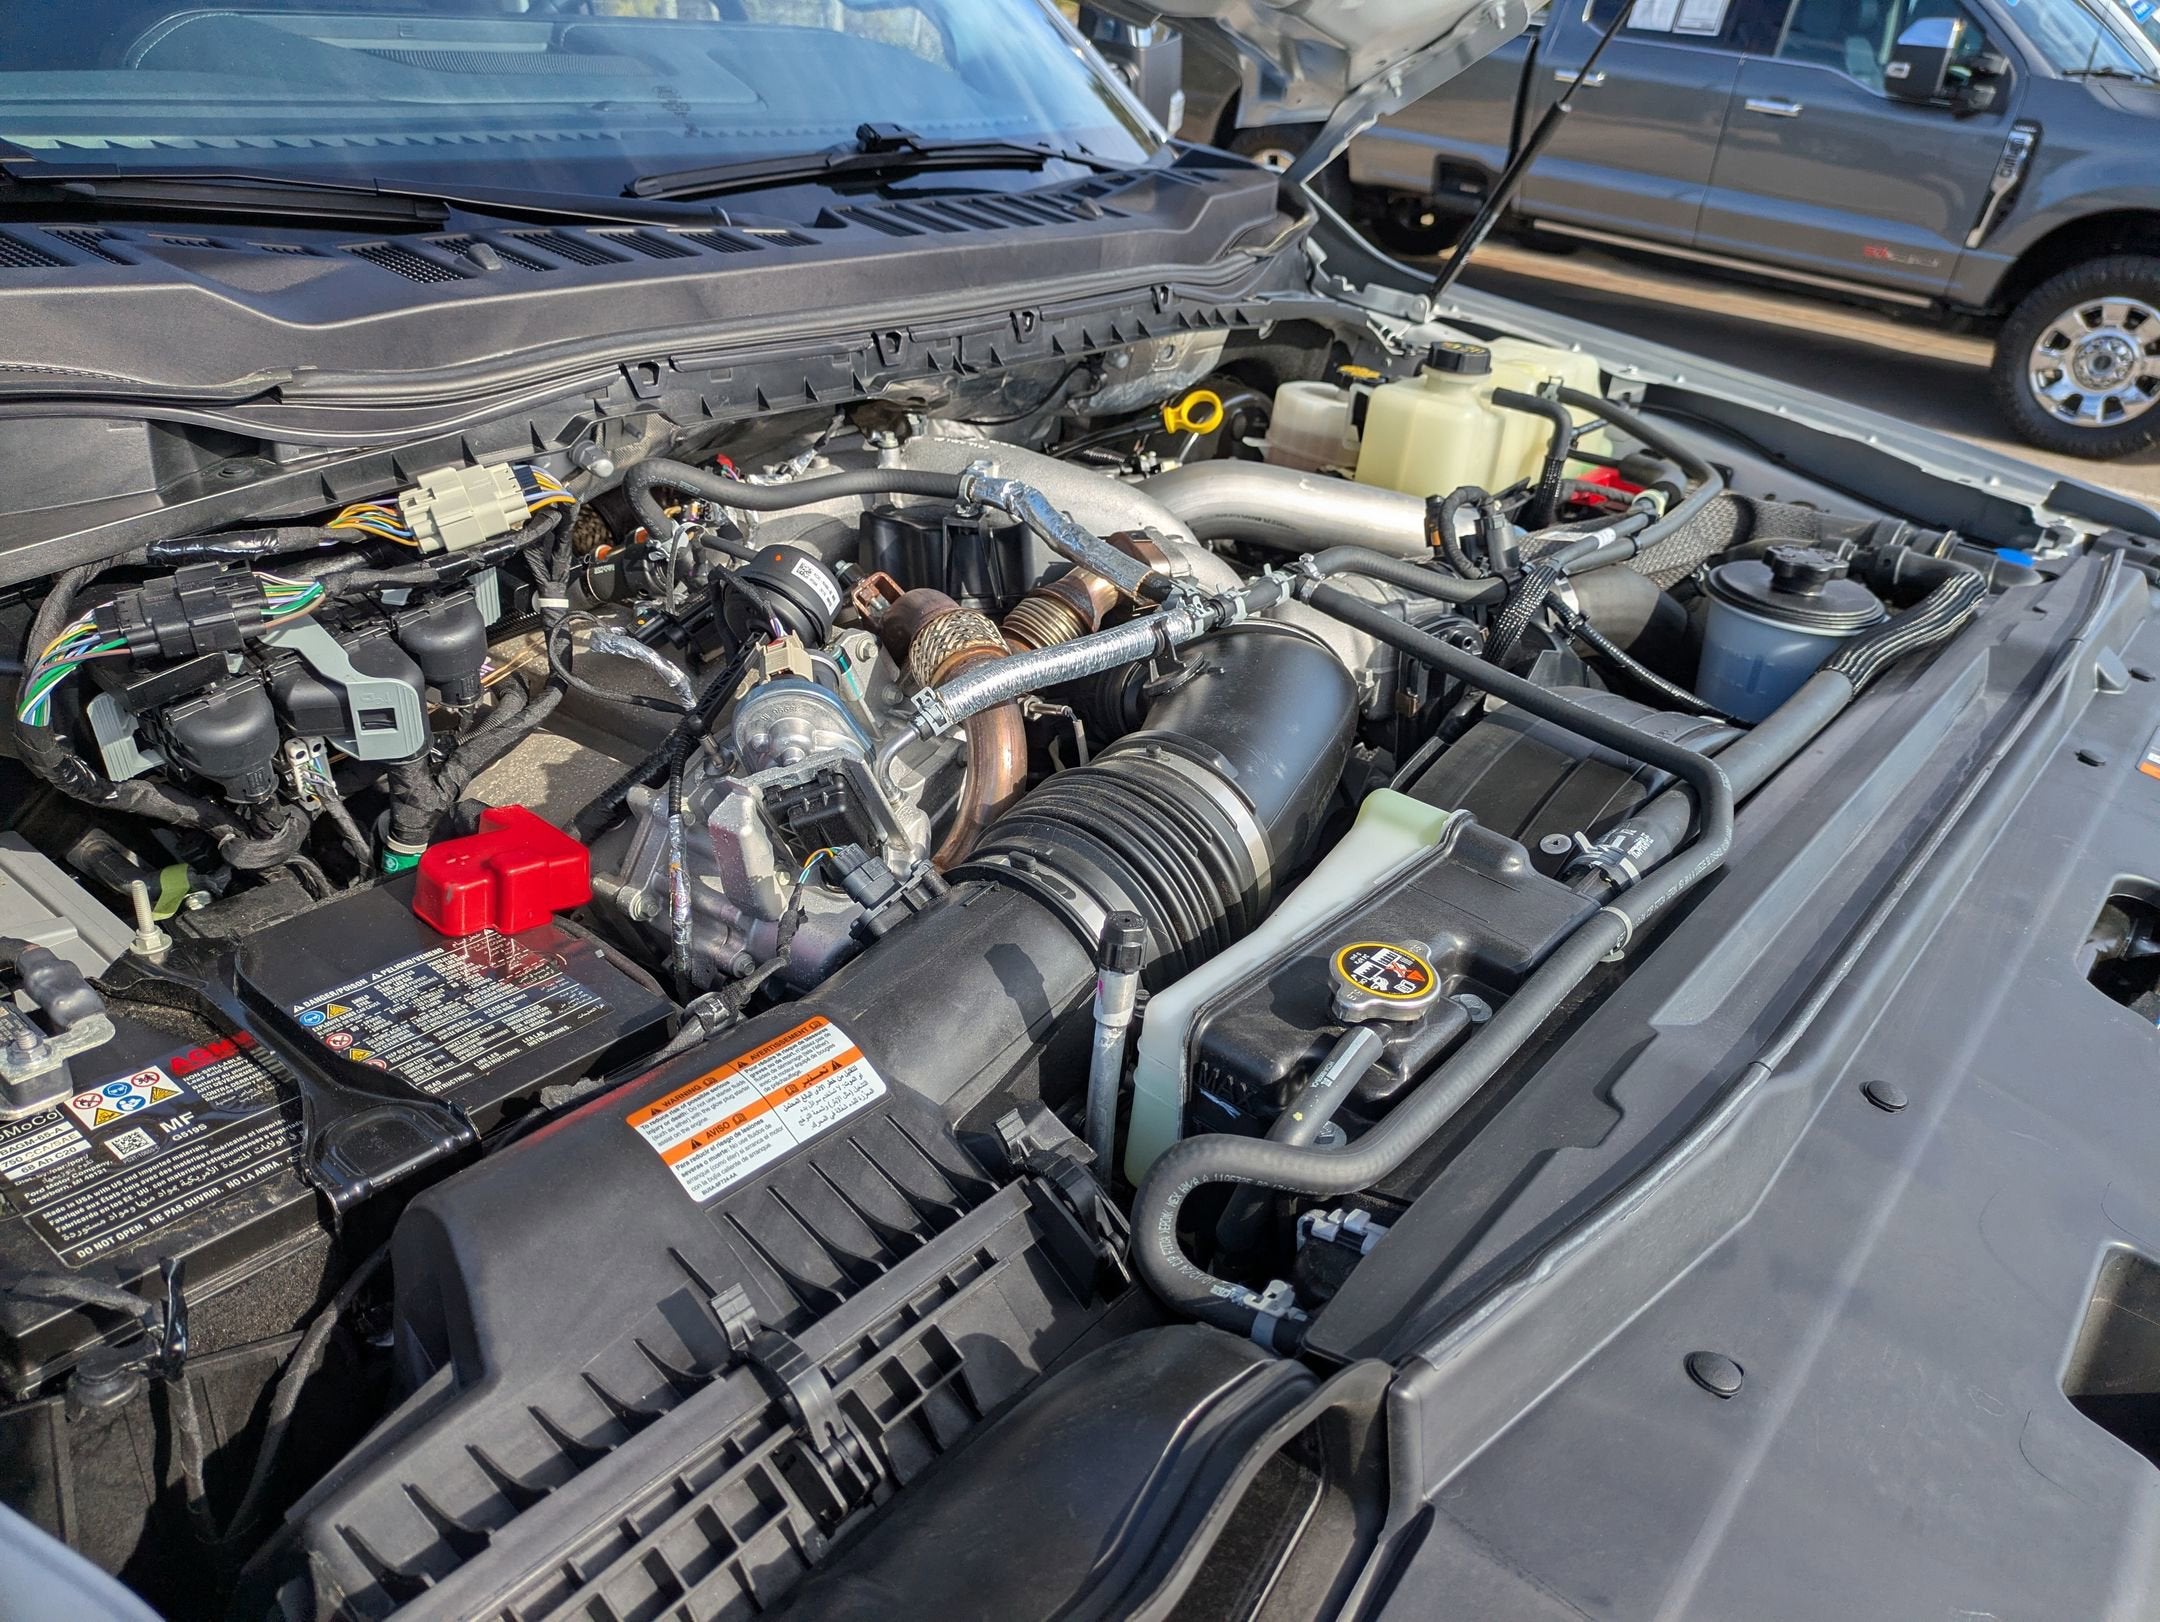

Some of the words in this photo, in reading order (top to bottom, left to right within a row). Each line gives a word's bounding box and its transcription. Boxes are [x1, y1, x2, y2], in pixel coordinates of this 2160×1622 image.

[301, 977, 369, 1008] DANGER/POISON
[379, 945, 444, 977] PELIGRO/VENENO
[521, 1035, 534, 1043] LEA
[532, 1030, 545, 1038] LAS
[749, 1026, 809, 1061] AVERTISSEMENT
[186, 1075, 206, 1086] Lead
[205, 1068, 223, 1078] Acid
[223, 1057, 249, 1071] Battery
[744, 1064, 758, 1073] Pour
[648, 1112, 669, 1126] reduce
[686, 1090, 711, 1106] possible
[708, 1079, 730, 1093] serious
[661, 1083, 702, 1108] WARNING
[709, 1099, 723, 1109] glow
[722, 1093, 735, 1103] plug
[715, 1086, 732, 1097] starter
[158, 1110, 197, 1134] MF
[703, 1120, 732, 1139] AVISO
[1, 1155, 23, 1168] 750
[23, 1132, 78, 1159] CCA/SAE
[54, 1145, 77, 1159] C20
[674, 1159, 690, 1170] Para
[688, 1147, 711, 1162] reducir
[714, 1134, 735, 1149] riesgo
[739, 1117, 764, 1133] lesiones
[23, 1186, 45, 1199] Ford
[44, 1175, 71, 1190] Motor
[71, 1157, 113, 1180] Company,
[48, 1205, 85, 1227] Fabriqué
[99, 1180, 140, 1203] États-Unis
[140, 1173, 158, 1185] avec
[172, 1150, 209, 1170] matériaux
[208, 1133, 248, 1155] américains
[166, 1161, 206, 1183] materiales
[680, 1162, 704, 1177] severas
[29, 1182, 72, 1205] Dearborn,
[83, 1167, 107, 1181] 48121
[42, 1204, 66, 1220] Made
[74, 1192, 93, 1205] USA
[92, 1185, 111, 1197] with
[137, 1157, 172, 1177] imported
[76, 1245, 94, 1259] DO
[93, 1235, 115, 1251] NOT
[163, 1203, 185, 1218] PAS
